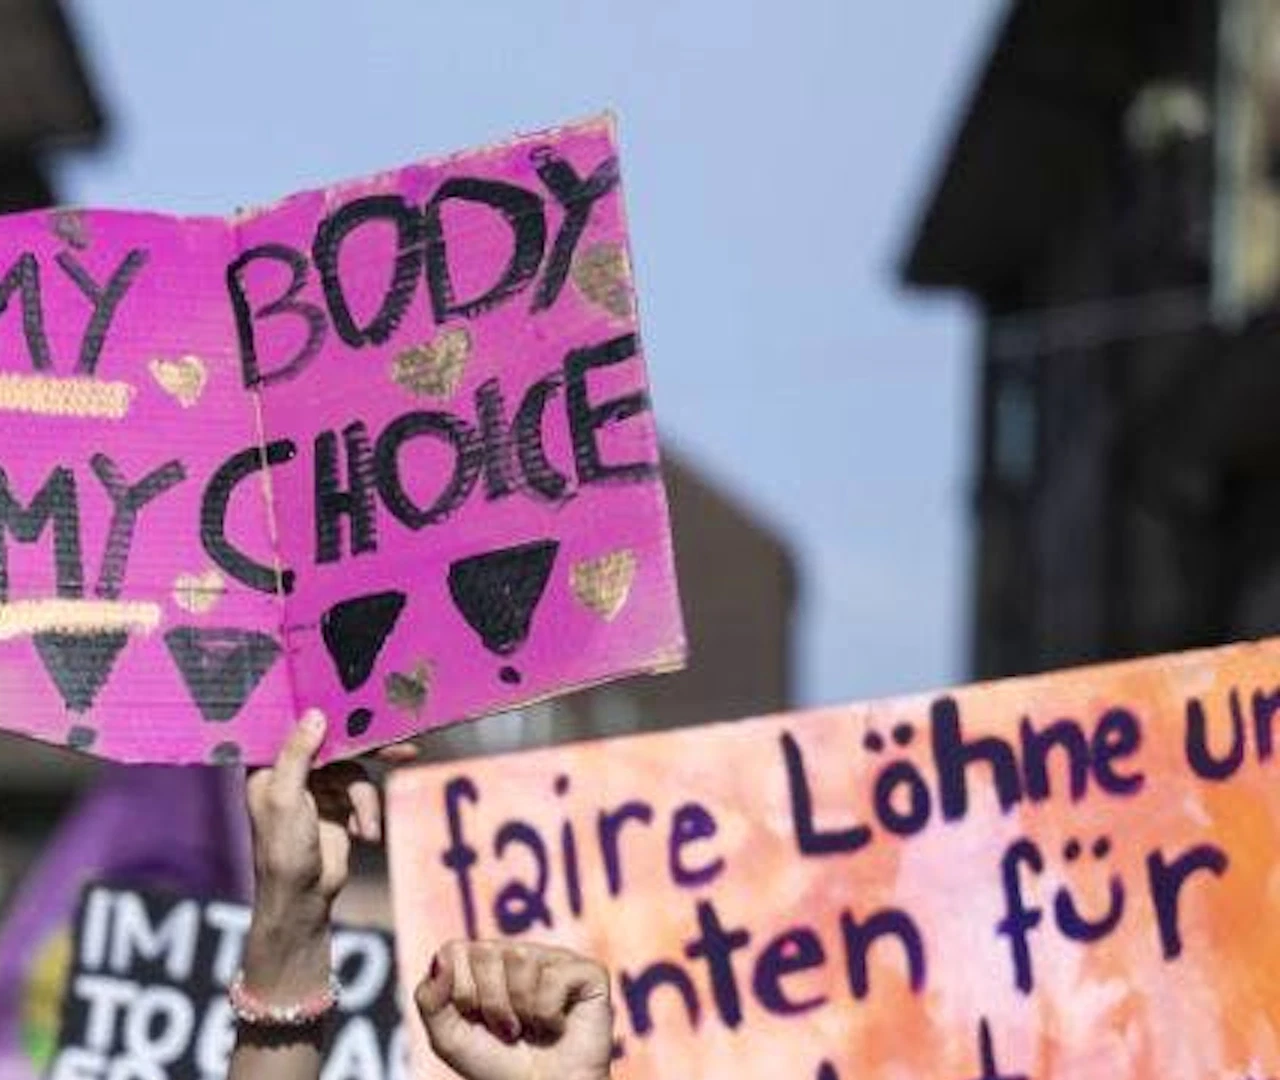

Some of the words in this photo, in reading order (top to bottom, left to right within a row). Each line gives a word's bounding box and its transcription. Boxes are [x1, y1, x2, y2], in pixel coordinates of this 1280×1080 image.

[226, 147, 621, 390] BODY
[200, 333, 658, 596] CHOICE
[441, 775, 721, 940] faire
[781, 695, 1145, 857] Löhne
[996, 834, 1229, 993] für
